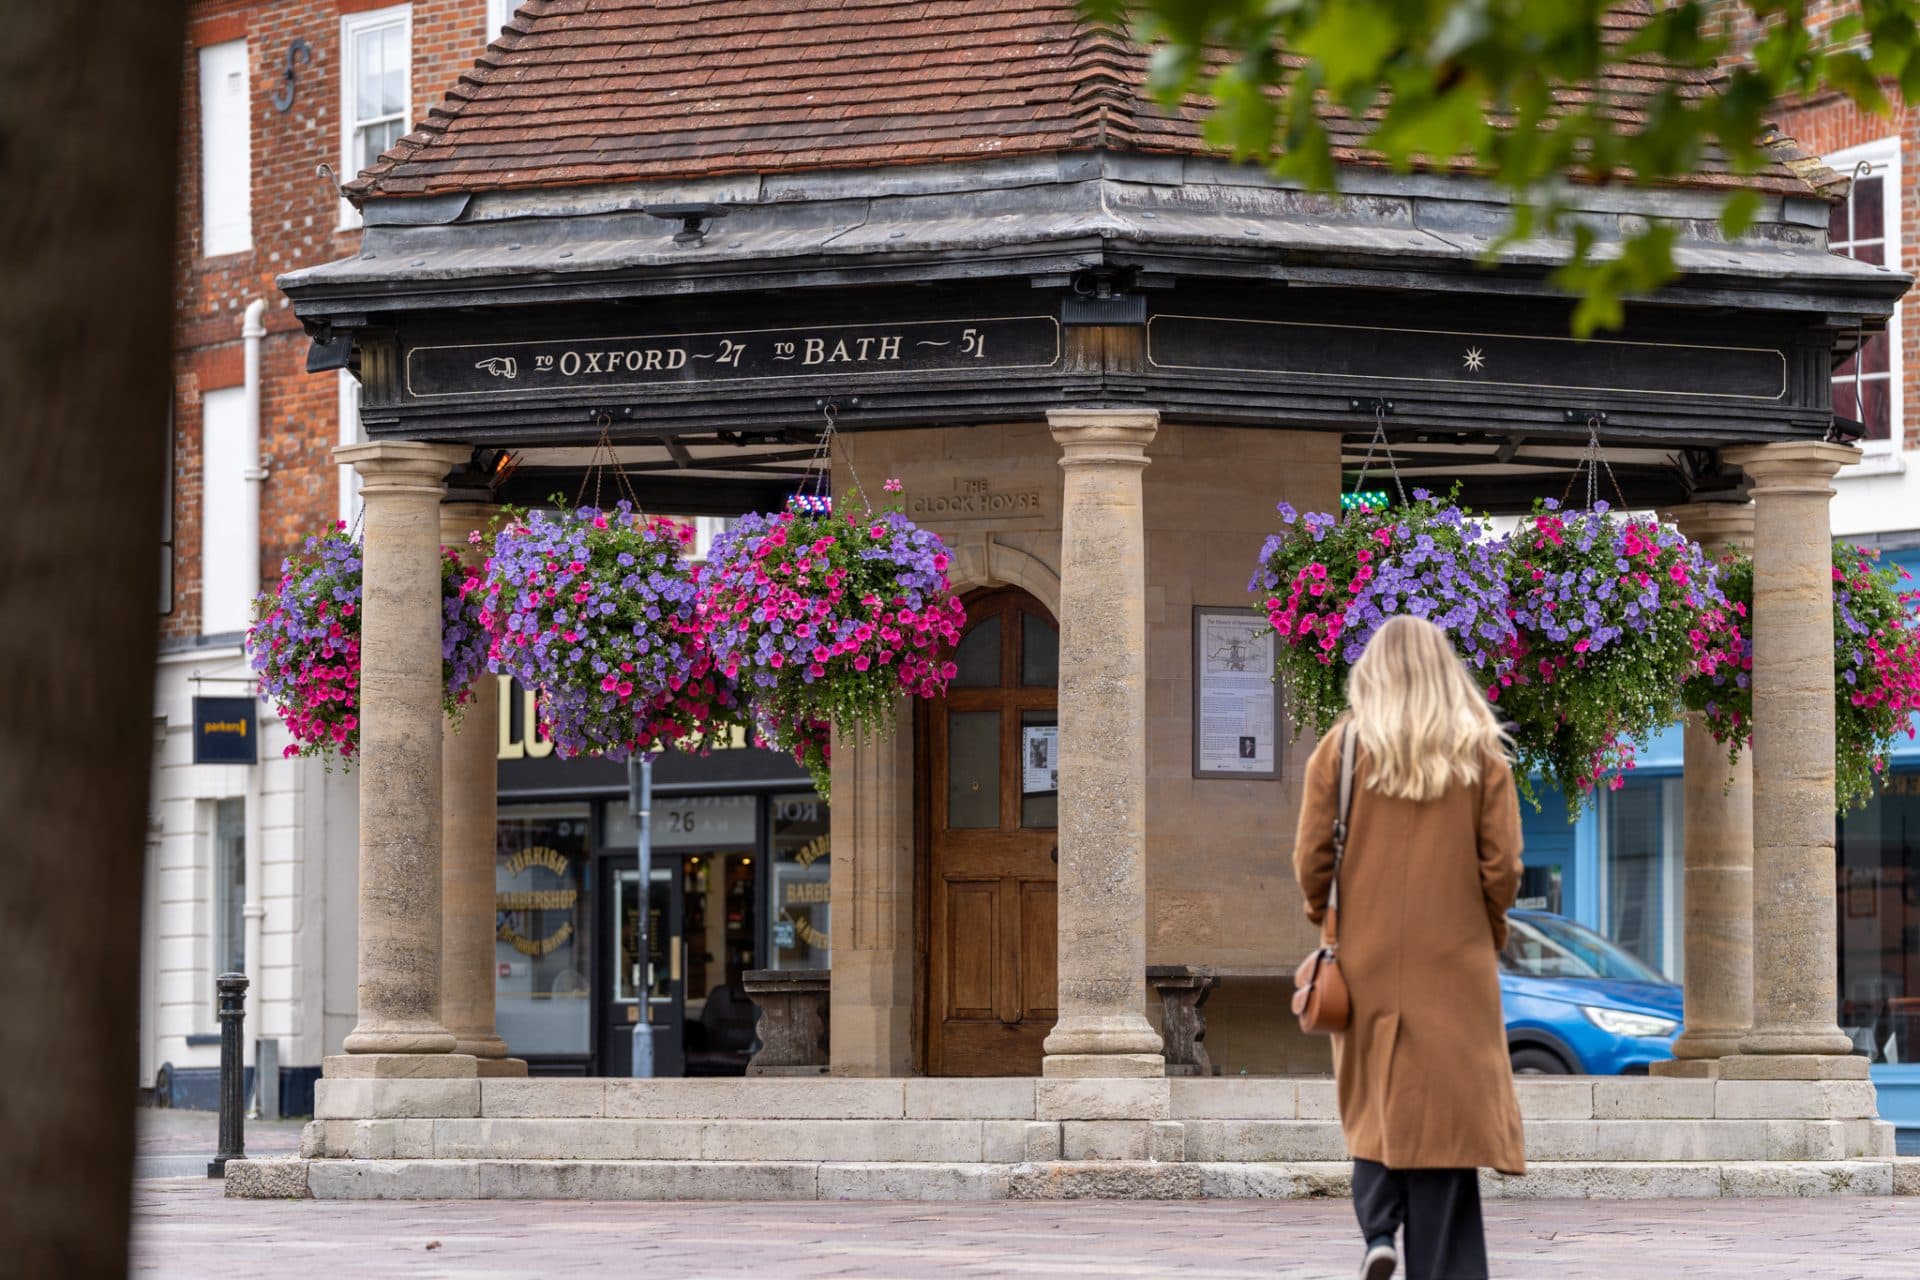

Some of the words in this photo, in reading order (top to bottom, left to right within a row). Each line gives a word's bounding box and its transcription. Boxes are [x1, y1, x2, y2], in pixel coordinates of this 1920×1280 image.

[534, 355, 554, 369] TO
[560, 348, 687, 376] OXFORD
[715, 339, 747, 367] 27
[774, 342, 795, 358] TO
[801, 336, 903, 365] BATH
[960, 329, 985, 358] 51
[963, 479, 988, 493] THE
[914, 495, 974, 513] CLOCK
[668, 811, 695, 832] 26
[505, 845, 568, 878] TURKISH
